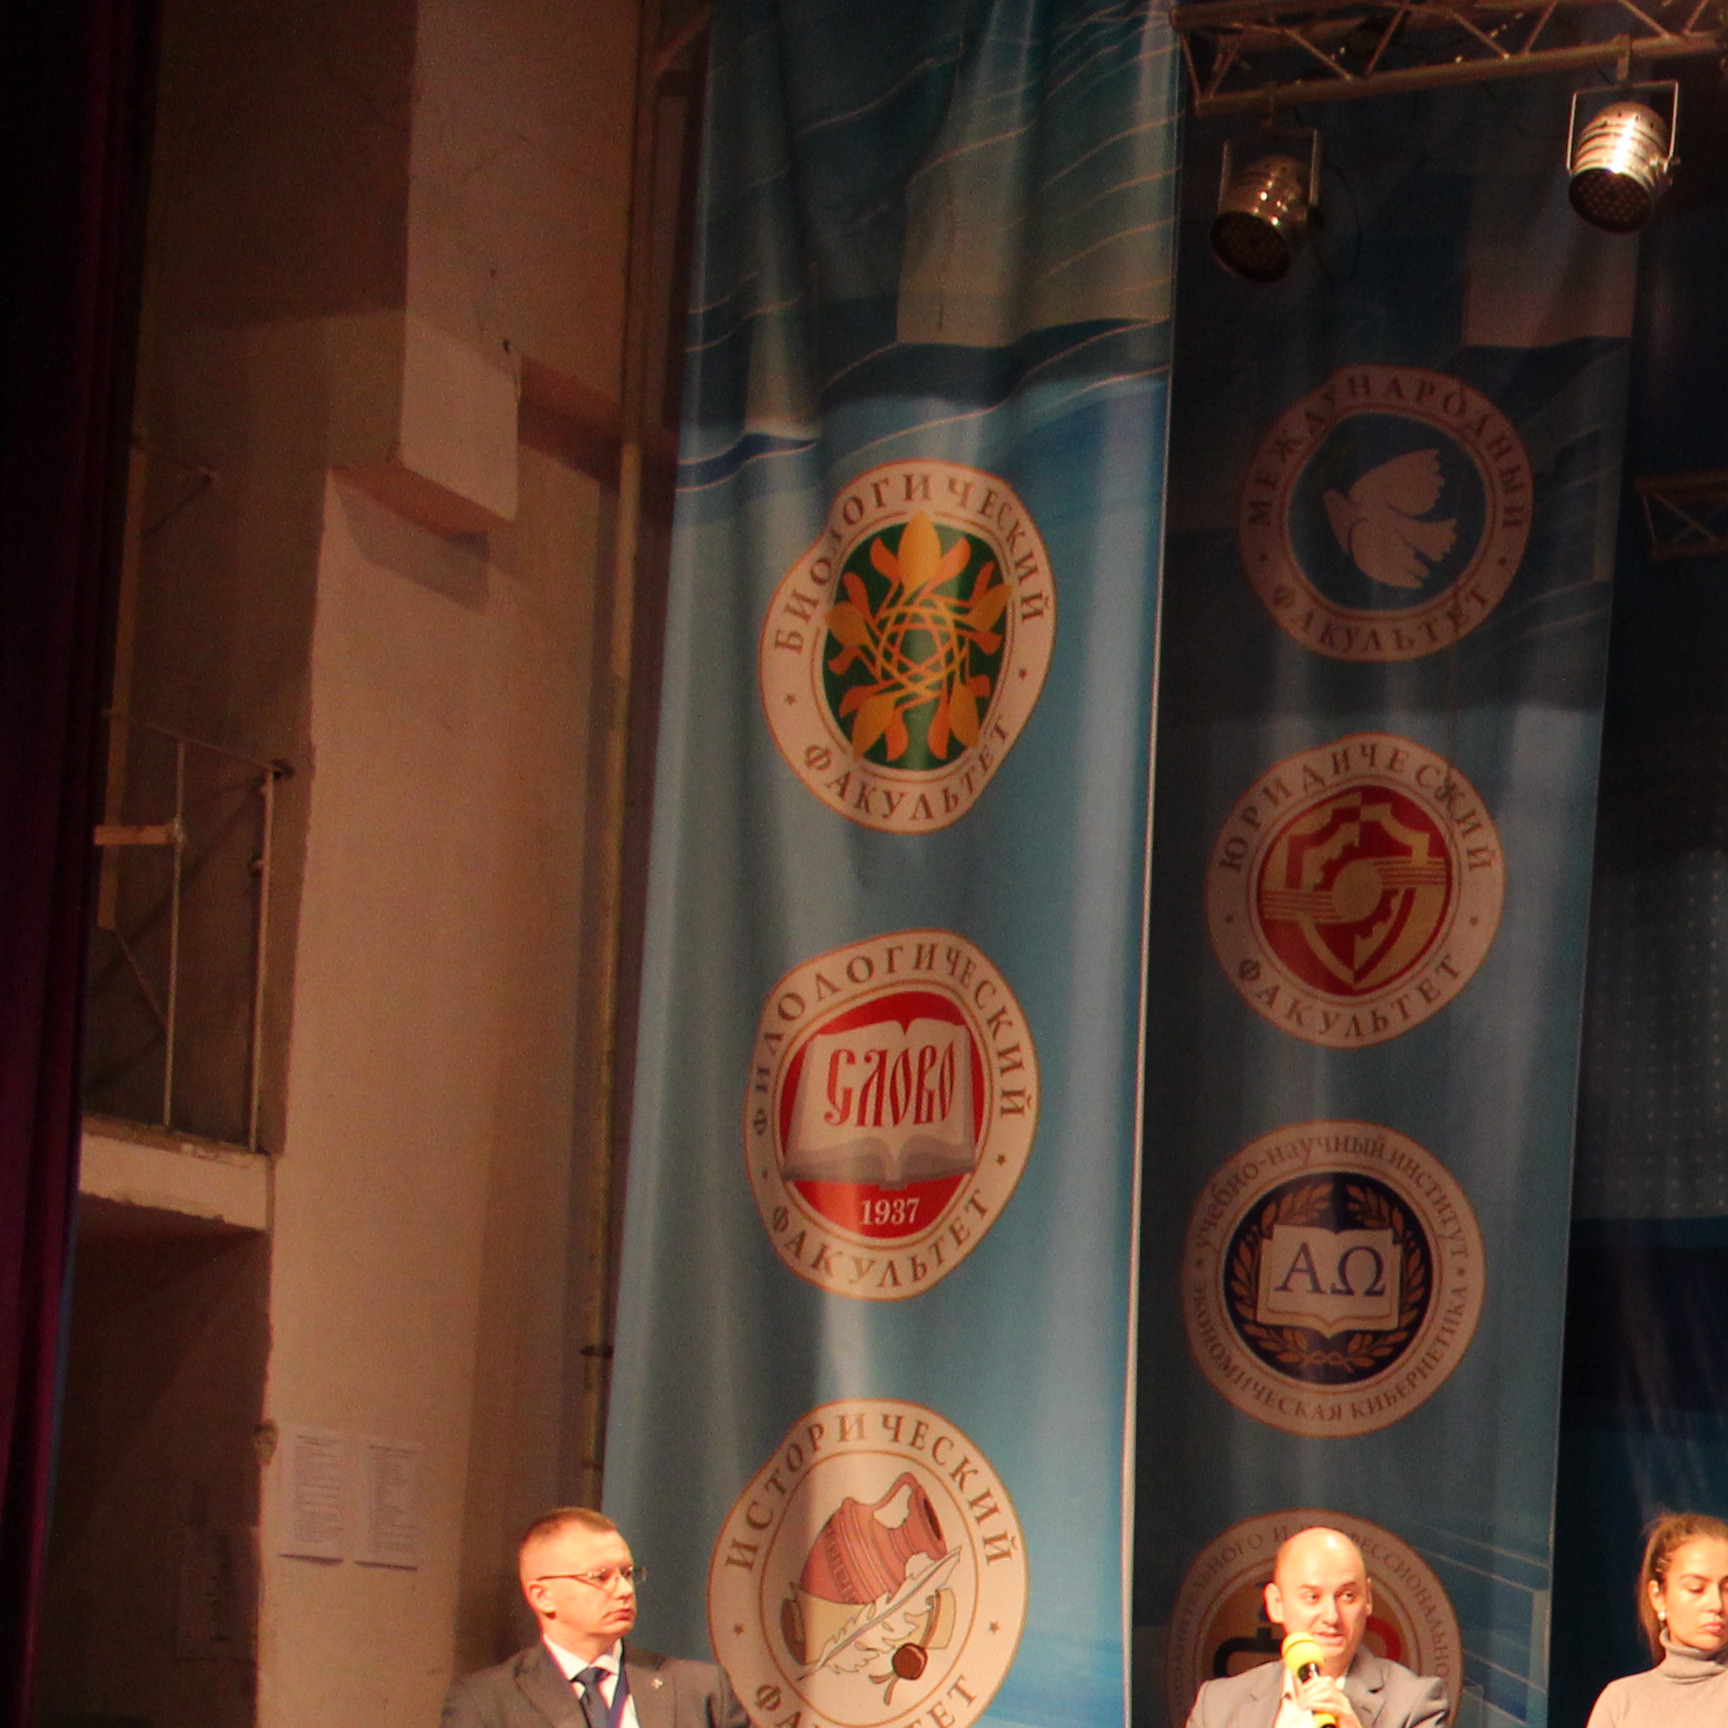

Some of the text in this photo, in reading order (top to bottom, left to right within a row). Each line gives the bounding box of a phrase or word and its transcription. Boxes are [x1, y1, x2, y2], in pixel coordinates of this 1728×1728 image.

[803, 713, 1010, 820] ФАКУЛЬТЕТ
[752, 942, 1034, 1138] ФИЛОЛОГИЧЕСКИЙ
[1238, 953, 1461, 1039] ФАКУЛЬТЕТ
[772, 1188, 992, 1288] ФАКУЛЬТЕТ
[861, 1197, 921, 1226] 1937
[724, 1412, 1019, 1575] ИСТОРИЧЕСКИЙ
